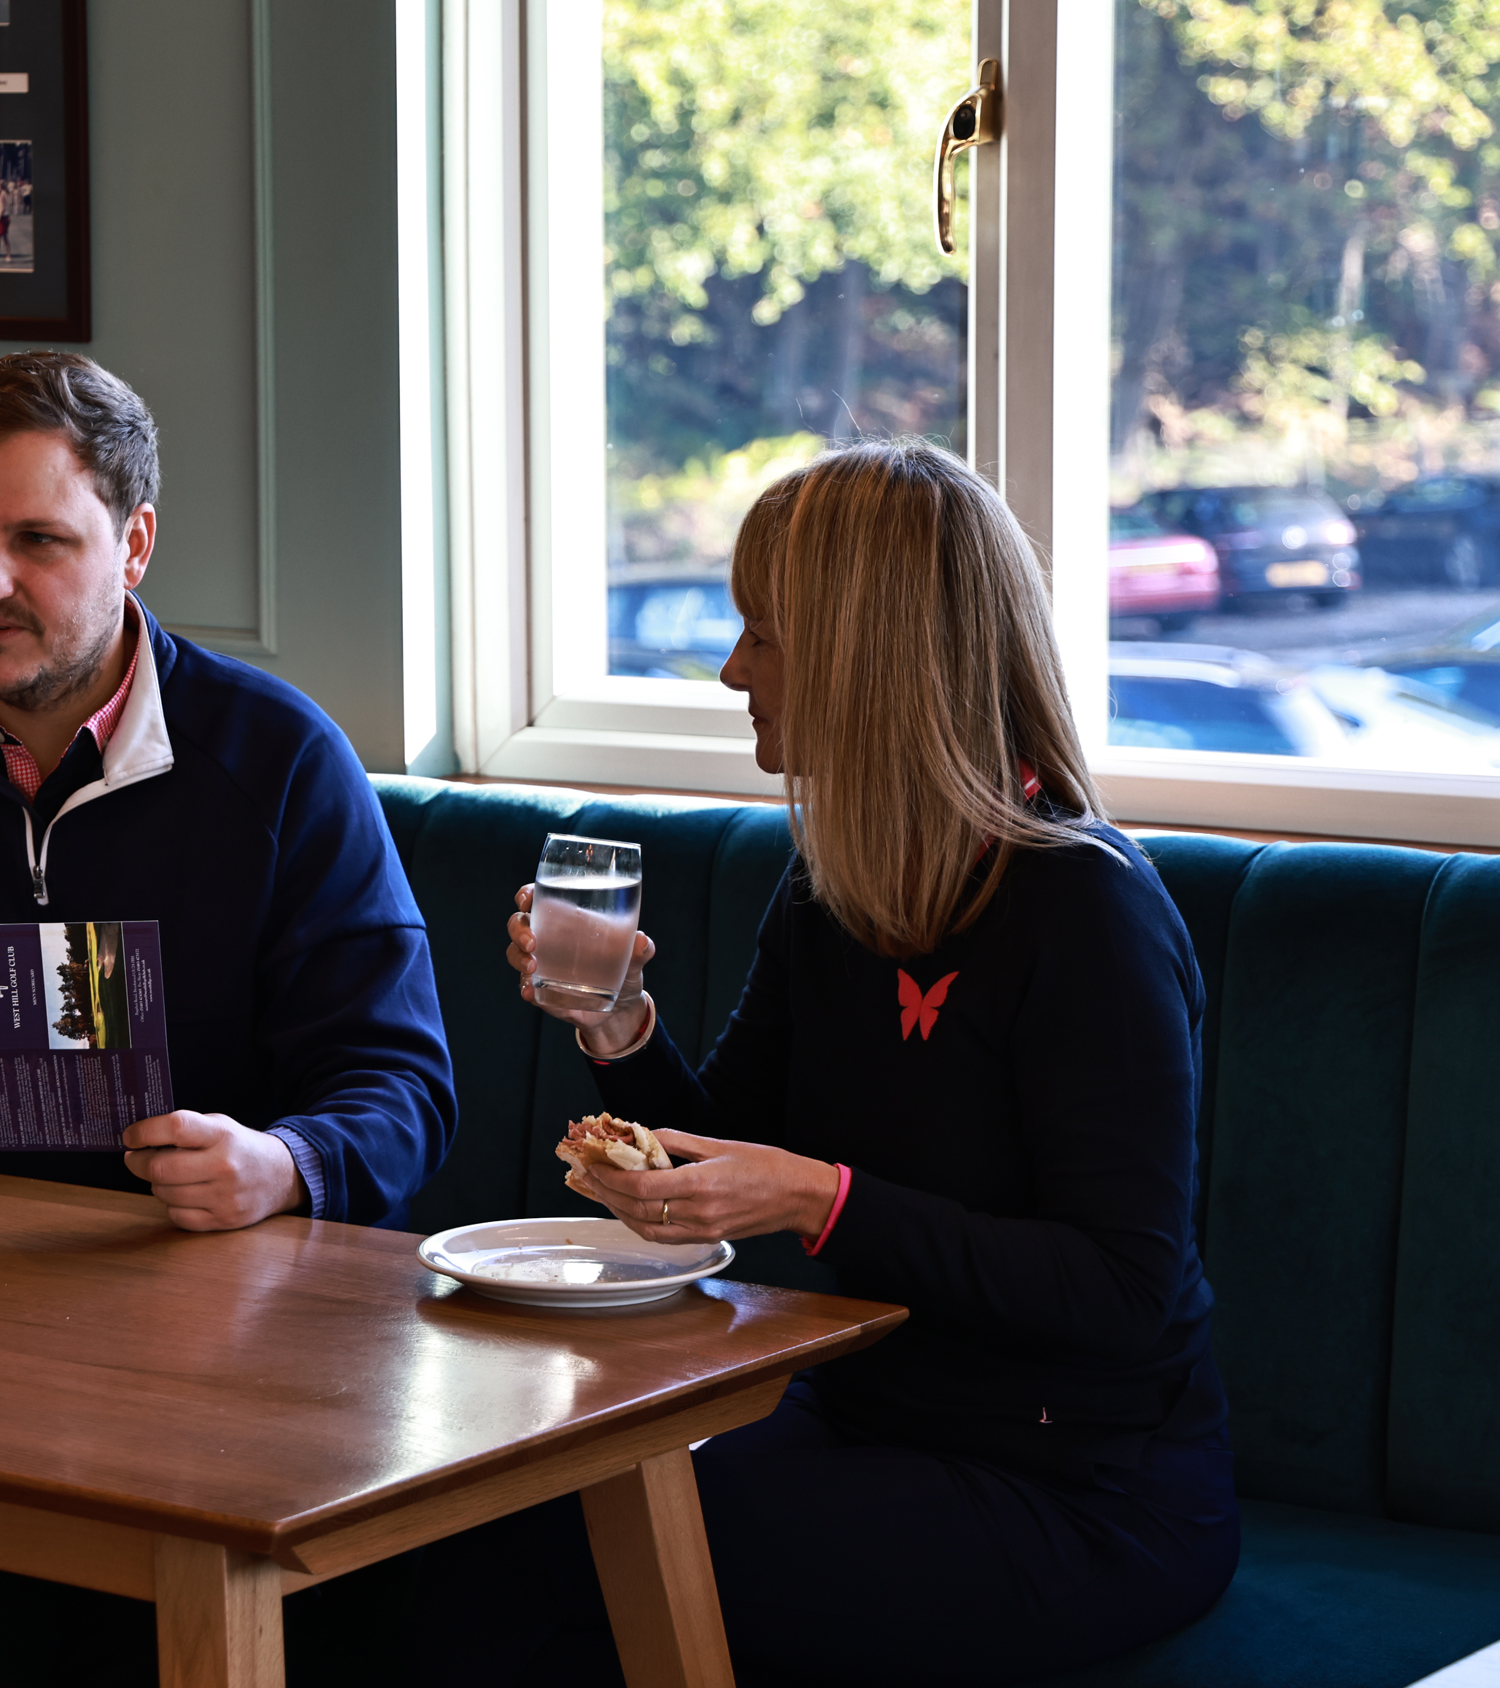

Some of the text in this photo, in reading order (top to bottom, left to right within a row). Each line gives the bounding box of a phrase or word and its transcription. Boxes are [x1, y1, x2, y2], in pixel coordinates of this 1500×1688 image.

[7, 946, 15, 966] CLUB
[9, 968, 17, 988] GOLF
[11, 989, 19, 1006] HILL
